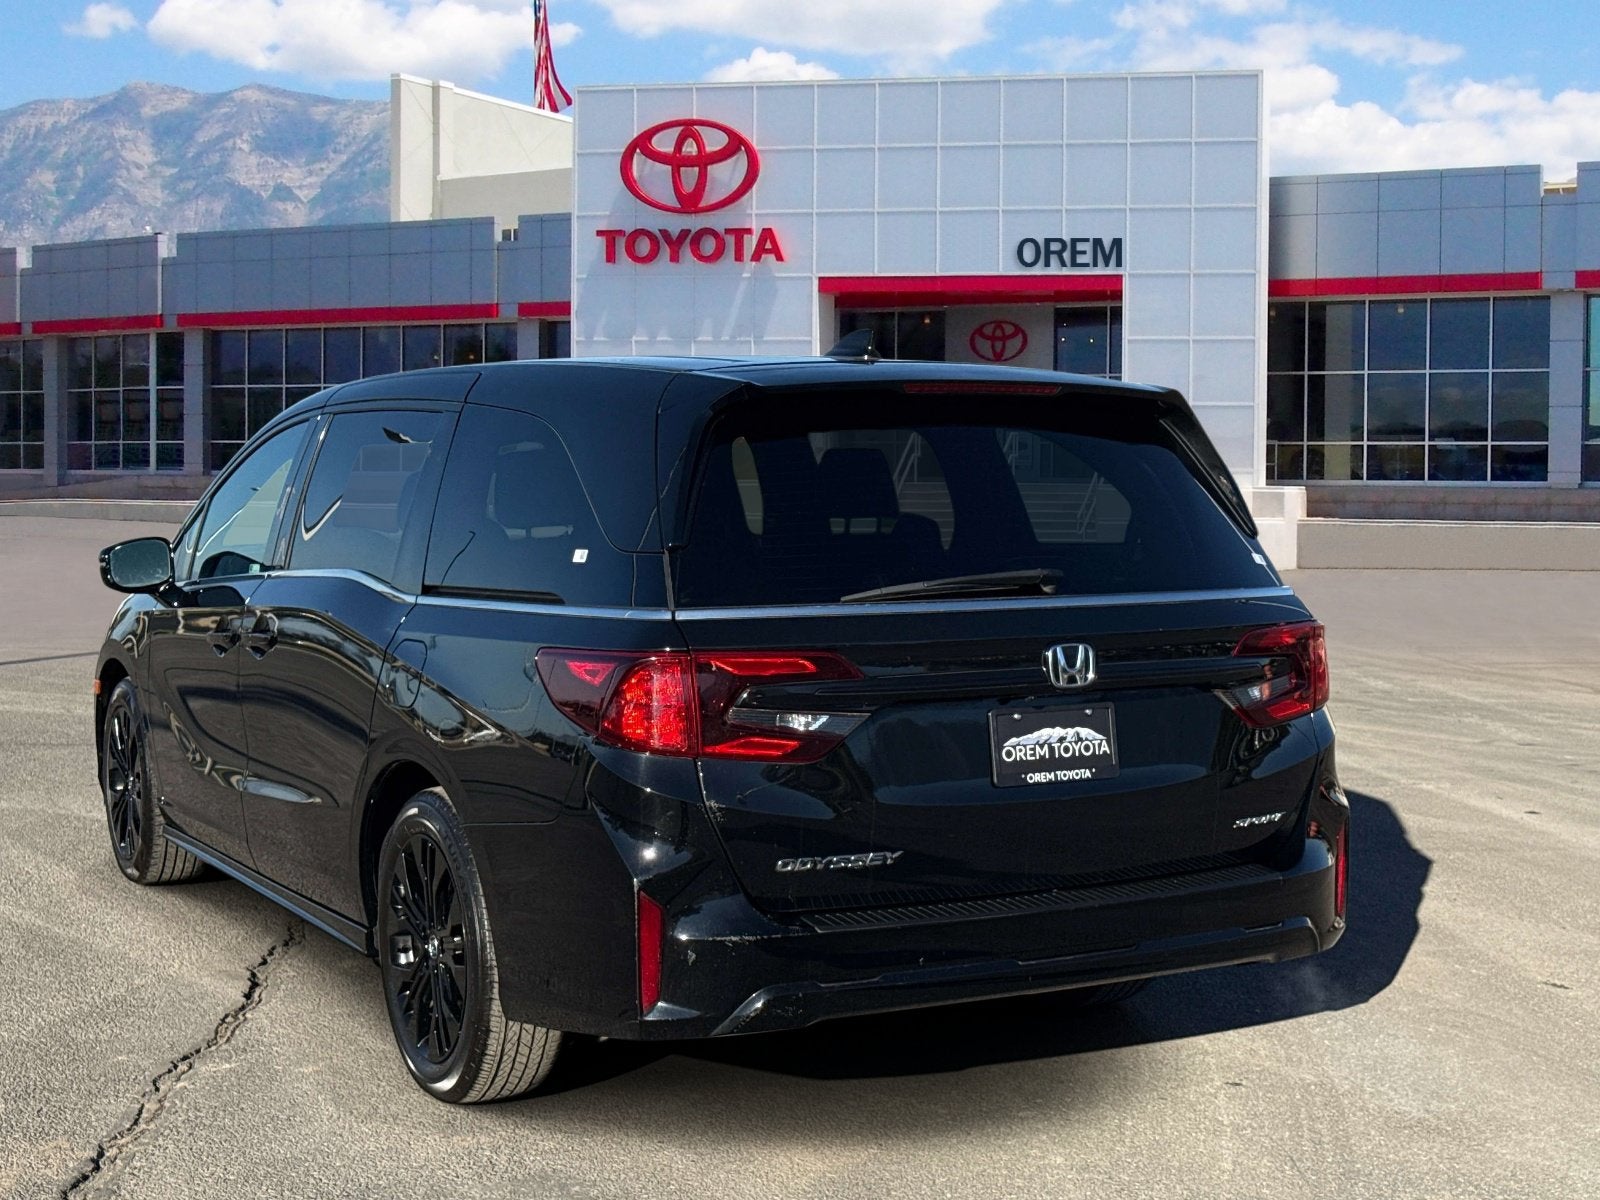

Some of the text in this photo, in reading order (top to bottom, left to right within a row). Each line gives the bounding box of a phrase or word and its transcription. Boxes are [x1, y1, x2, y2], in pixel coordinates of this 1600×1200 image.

[596, 227, 784, 264] TOYOTA
[1017, 237, 1123, 268] OREM
[1002, 740, 1110, 762] OREM TOYOTA
[1027, 769, 1091, 783] OREM TOYOTA
[1232, 811, 1287, 829] SPORT
[775, 850, 905, 873] ODYSSEY
